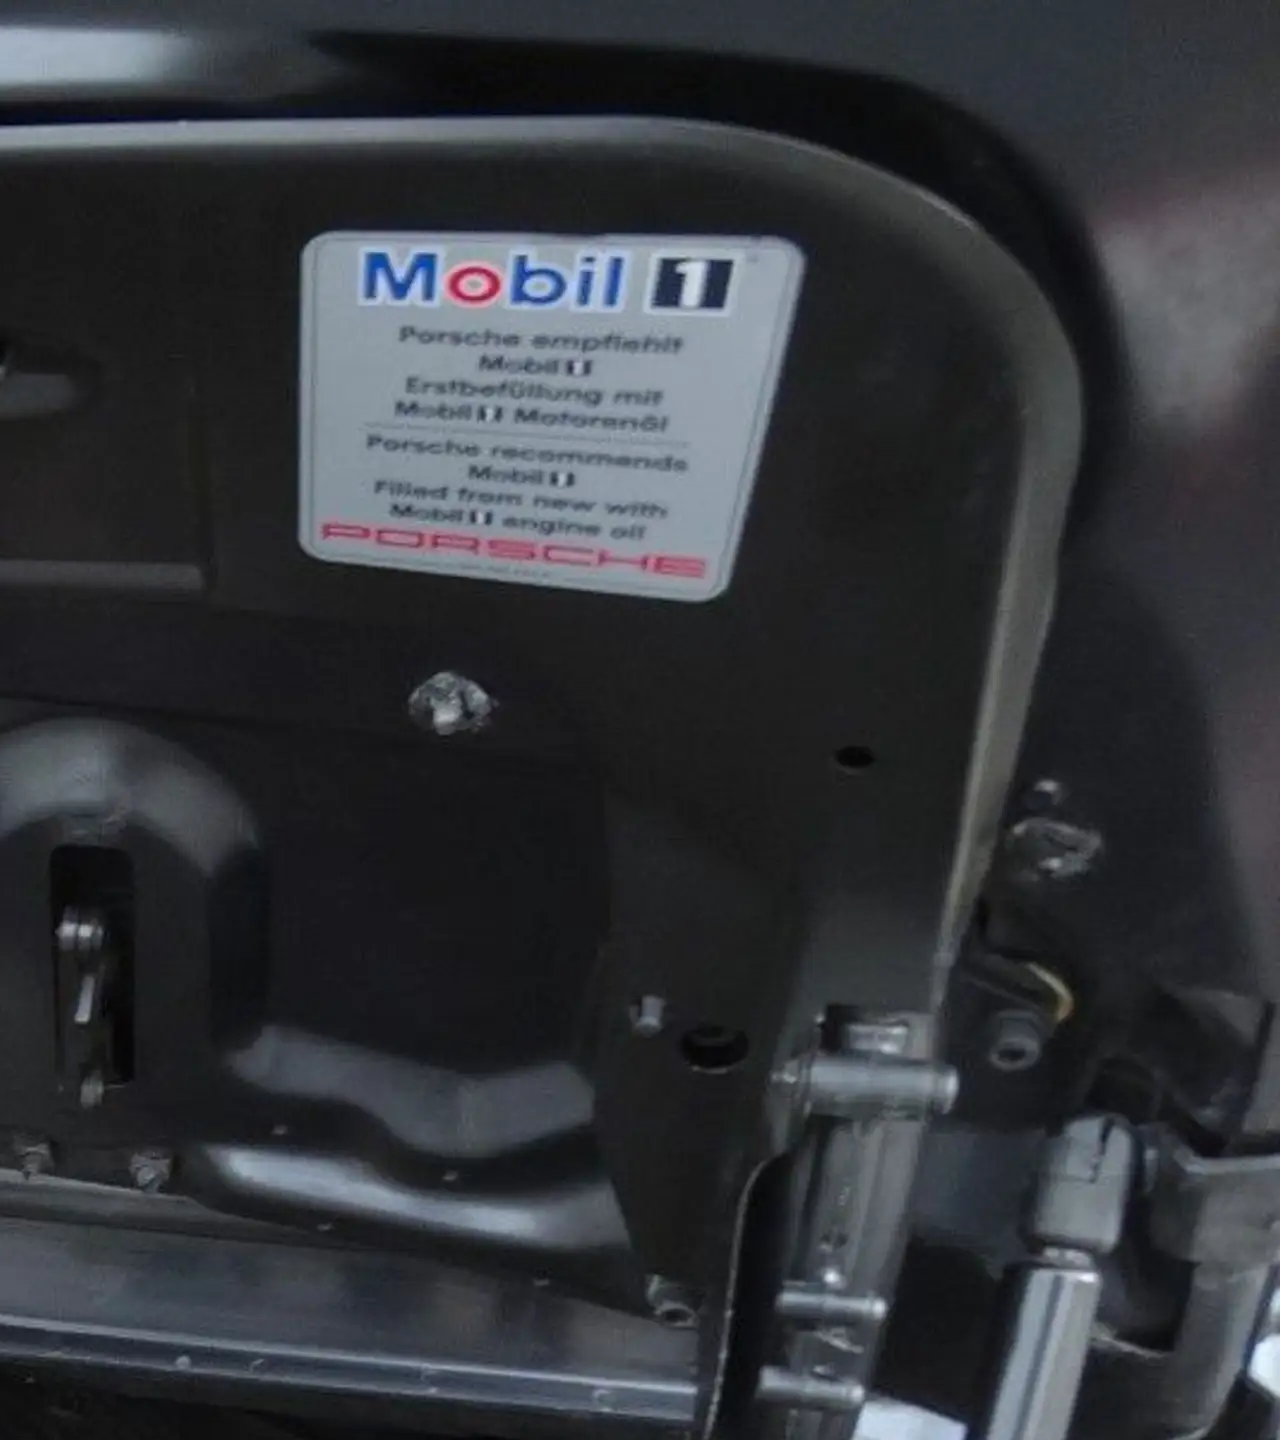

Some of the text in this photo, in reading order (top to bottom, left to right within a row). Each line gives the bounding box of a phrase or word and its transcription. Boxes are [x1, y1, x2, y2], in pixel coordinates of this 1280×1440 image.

[363, 251, 625, 307] Mobil
[398, 325, 684, 354] Porsche empfiehlt
[478, 354, 559, 374] Mobil
[404, 375, 664, 407] Erstbefüllung mit
[393, 400, 473, 421] Mobil
[514, 409, 670, 432] Motorenöl
[366, 434, 688, 473] Porsche recommends
[467, 464, 544, 485] Mobil
[373, 480, 669, 518] Filled from new with
[389, 503, 464, 522] Mobil
[501, 516, 602, 536] engine
[609, 524, 647, 540] oil
[321, 522, 707, 579] PORSCHE
